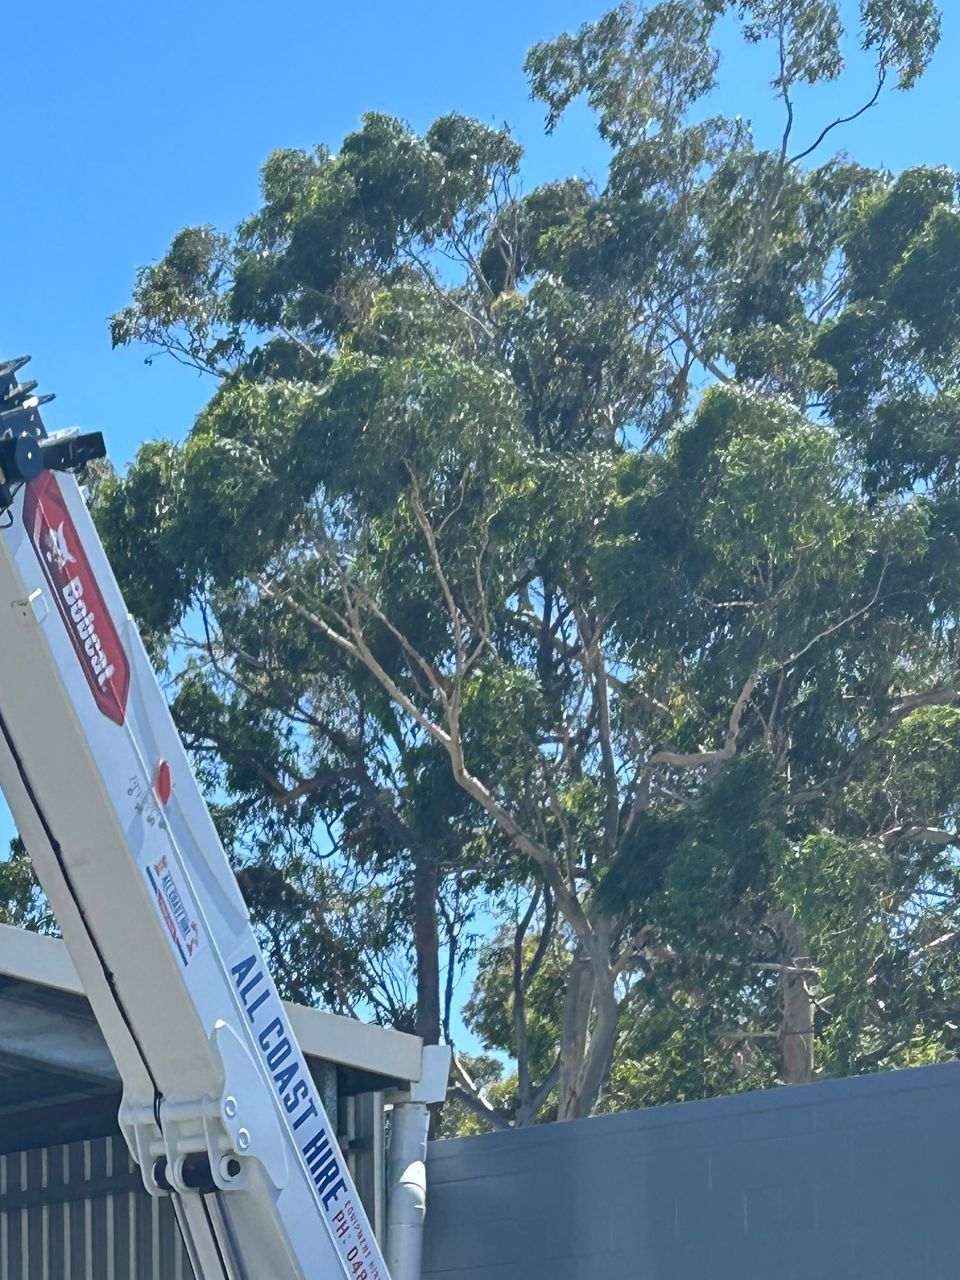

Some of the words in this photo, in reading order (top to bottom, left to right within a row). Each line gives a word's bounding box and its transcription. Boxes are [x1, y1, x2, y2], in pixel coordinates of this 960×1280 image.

[62, 575, 115, 688] Bobcat
[231, 954, 271, 1023] ALL
[258, 1016, 318, 1130] COAST
[302, 1128, 348, 1212] HIRE
[332, 1209, 351, 1245] PH:
[344, 1200, 372, 1259] EQUIPMENT
